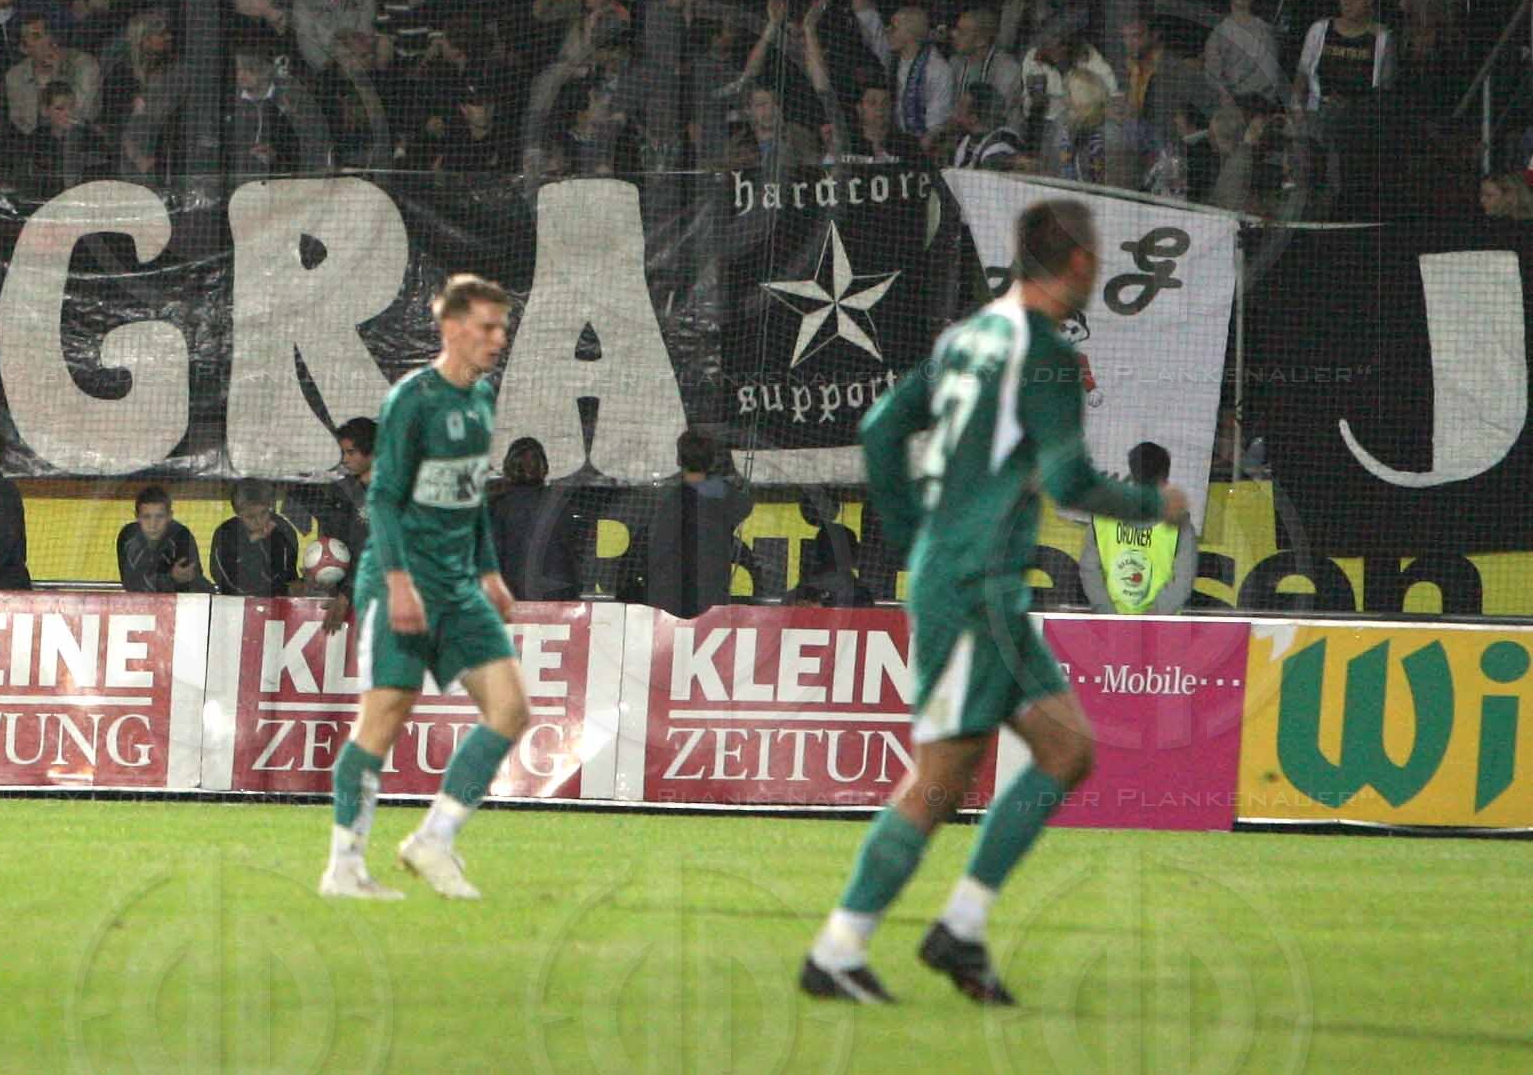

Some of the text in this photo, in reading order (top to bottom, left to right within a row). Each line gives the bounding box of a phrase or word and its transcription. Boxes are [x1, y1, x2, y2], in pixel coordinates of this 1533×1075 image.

[731, 170, 932, 216] hardcore
[670, 626, 915, 705] KLEIN
[662, 727, 916, 783] ZEITUN
